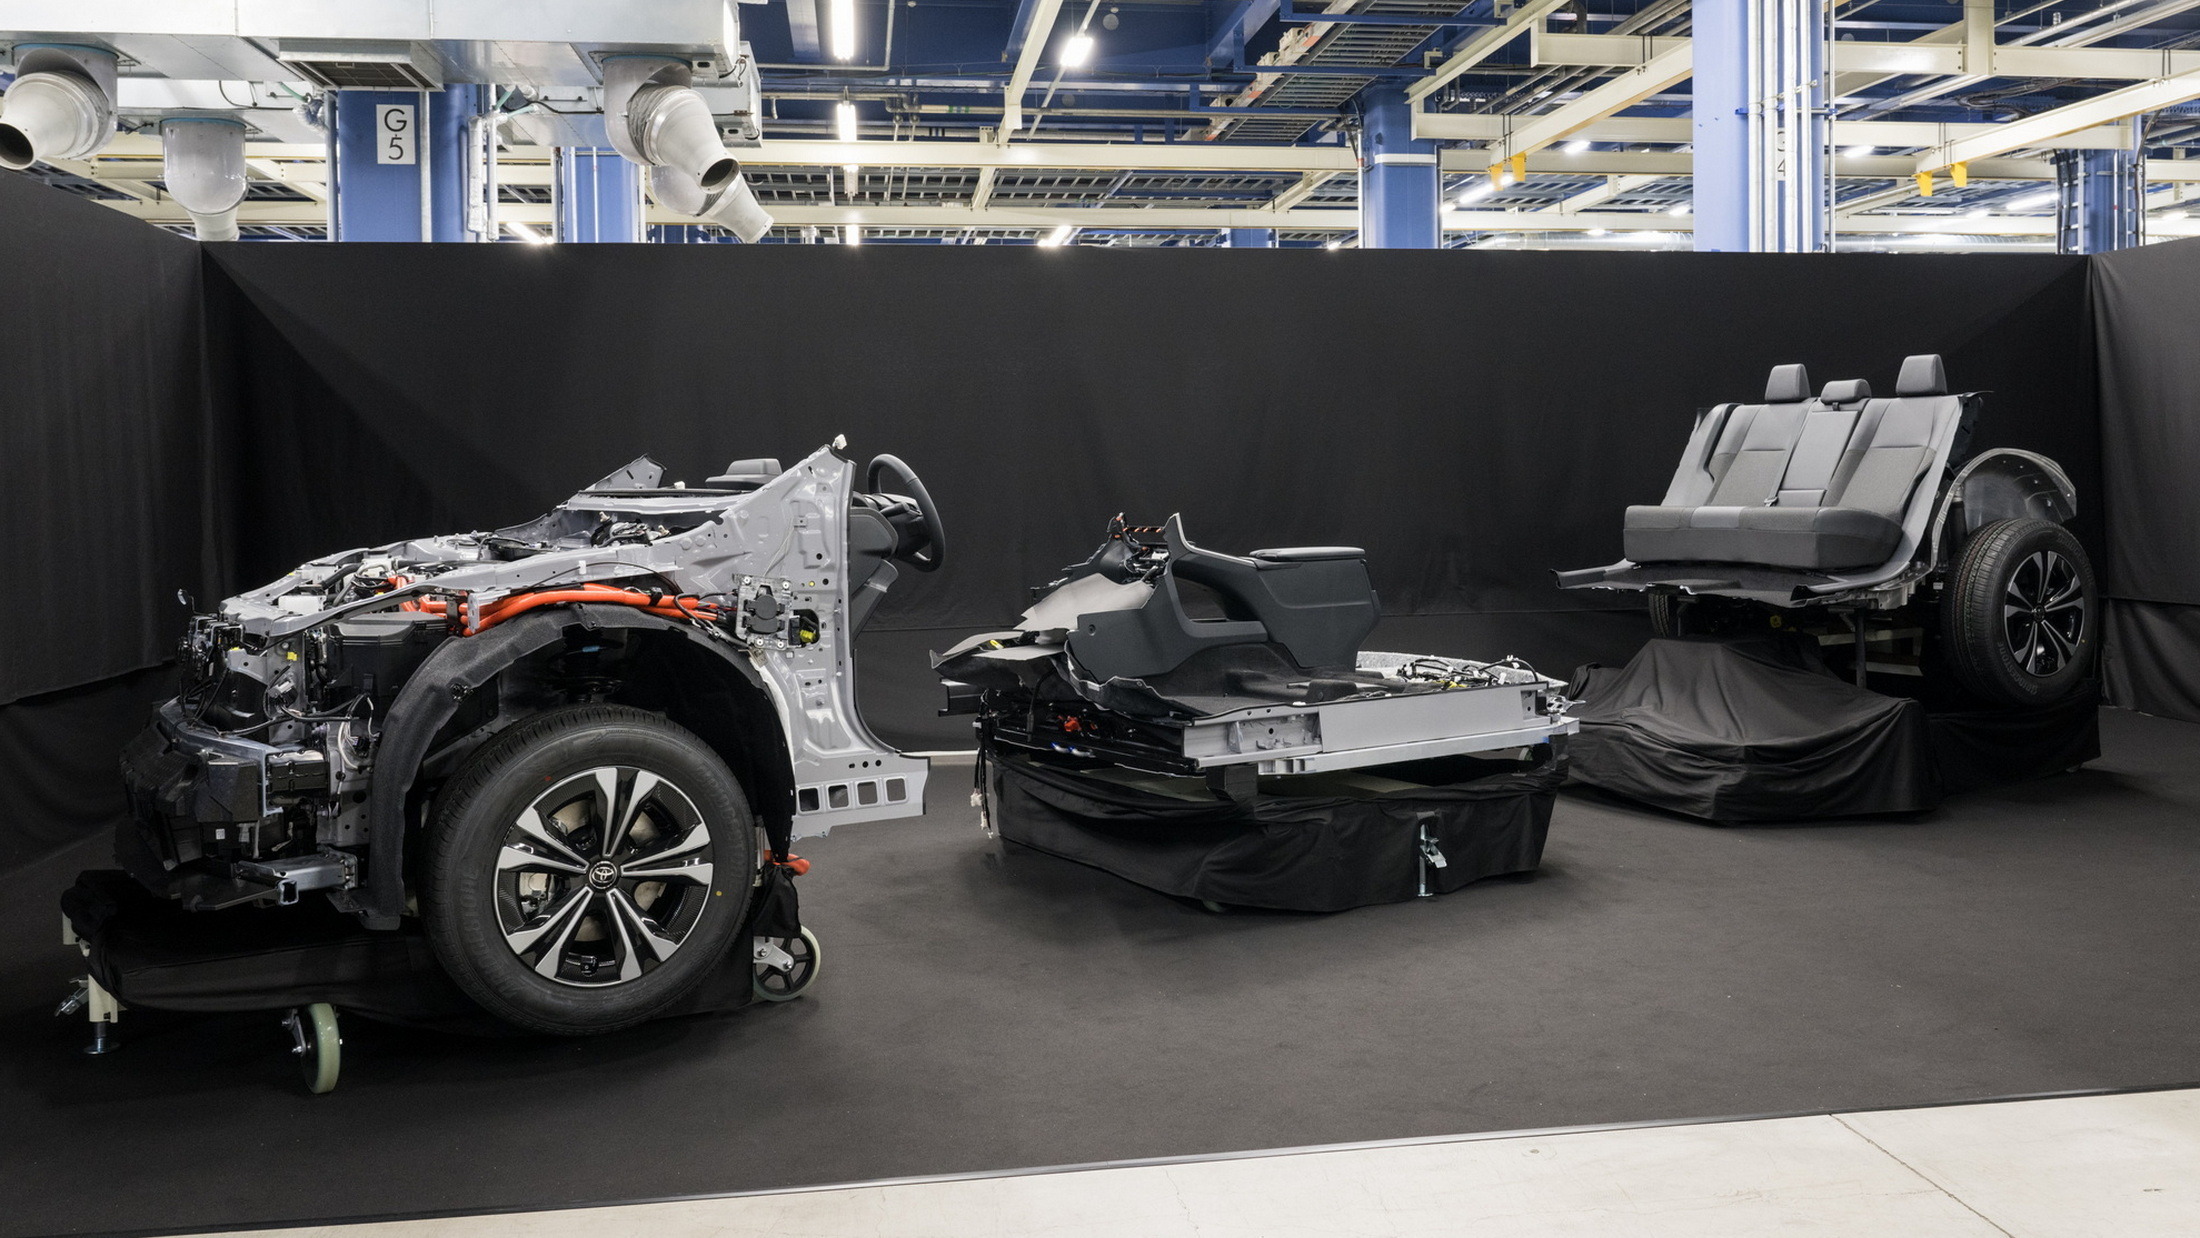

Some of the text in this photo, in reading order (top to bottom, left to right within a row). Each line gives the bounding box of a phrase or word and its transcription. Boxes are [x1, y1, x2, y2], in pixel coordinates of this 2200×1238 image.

[384, 108, 407, 132] G
[388, 137, 404, 160] 5
[1997, 641, 2039, 696] BRIDGESTONE
